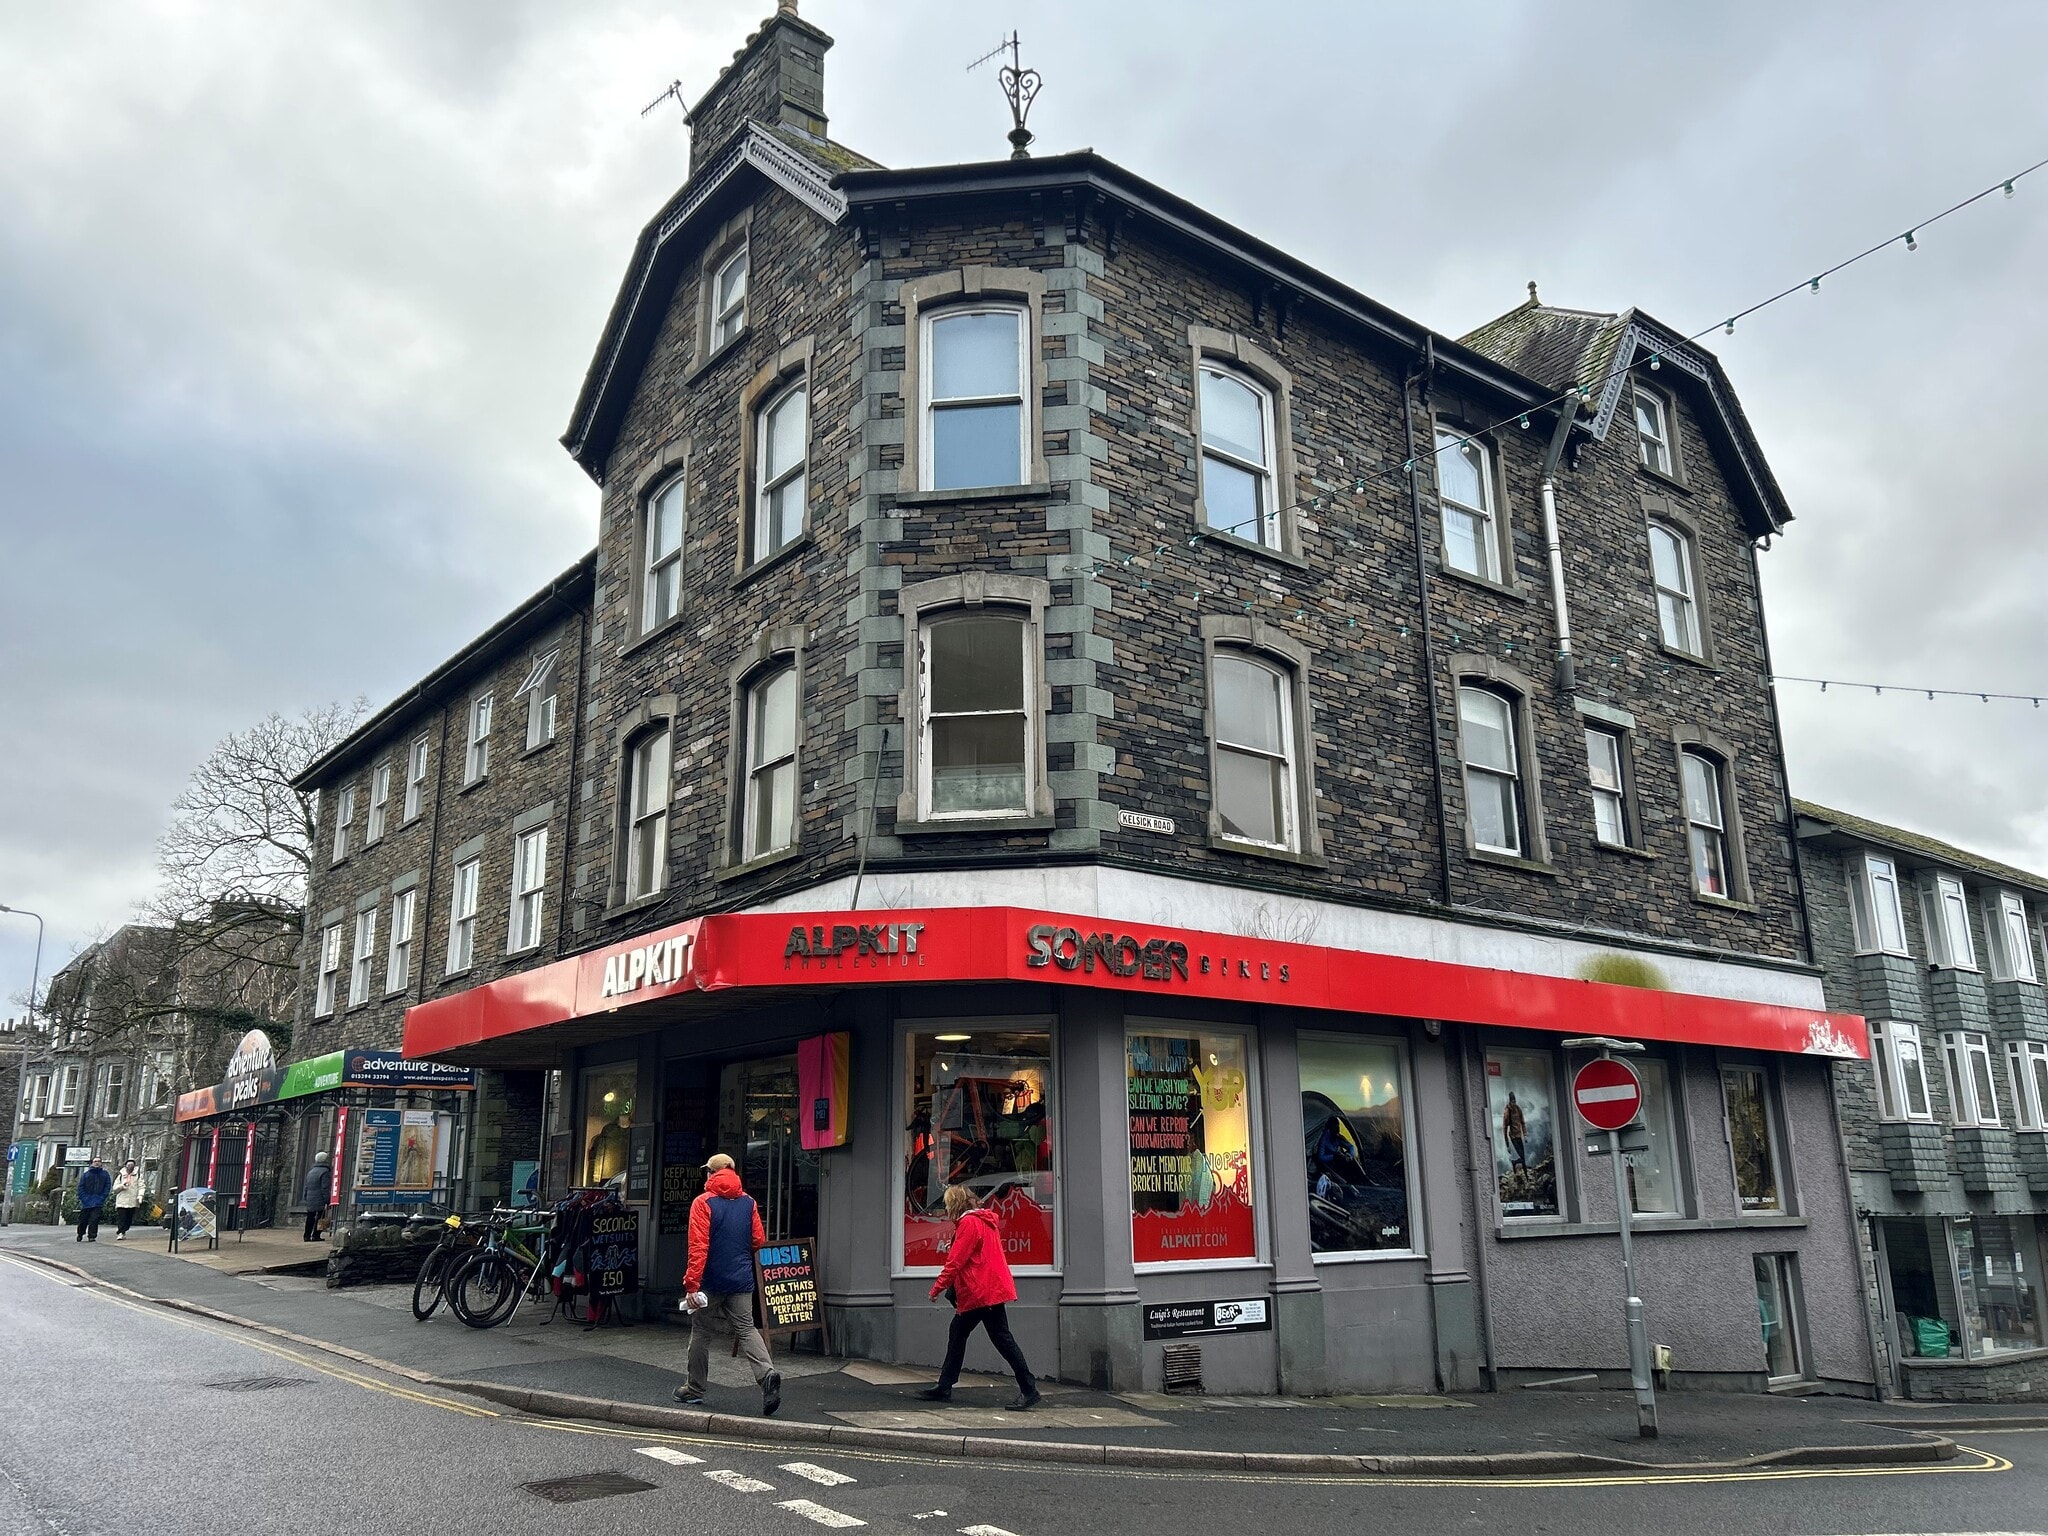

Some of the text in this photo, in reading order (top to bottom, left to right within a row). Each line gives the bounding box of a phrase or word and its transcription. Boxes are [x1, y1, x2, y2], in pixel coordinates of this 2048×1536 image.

[1122, 813, 1171, 831] KELSICK ROAD
[783, 921, 925, 958] ALPKIT
[1026, 924, 1290, 982] SONDER BIKES
[601, 932, 692, 998] ALPKIT
[784, 954, 926, 971] AMBLESIDE
[228, 1048, 270, 1078] adventure
[362, 1058, 470, 1075] adventure peaks
[1165, 1057, 1188, 1073] COAT?
[314, 1072, 339, 1088] ADVENTURE
[1128, 1077, 1189, 1094] CAN WE WASH YOUR
[231, 1073, 259, 1109] peaks
[1129, 1094, 1189, 1110] SLEEPING BAG?
[1130, 1116, 1190, 1132] CAN WE REPROOF
[1131, 1133, 1191, 1149] YOUR WATERPROOF?
[332, 1114, 345, 1197] SALE
[242, 1129, 254, 1203] SALE
[664, 1167, 684, 1178] KEEP
[1131, 1156, 1192, 1174] CAN WE MEND YOUR
[663, 1178, 699, 1190] OLD KIT
[1132, 1174, 1192, 1192] BROKEN HEART?
[663, 1189, 691, 1202] GOING!
[592, 1232, 635, 1245] WETSUITS
[1160, 1233, 1228, 1249] ALPKIT.COM
[759, 1245, 801, 1266] WASH
[602, 1270, 624, 1287] £50
[763, 1265, 811, 1281] REPROOF
[764, 1283, 787, 1297] GEAR
[765, 1291, 817, 1306] LOOKED AFTER
[772, 1302, 814, 1315] PERFORMS
[1149, 1307, 1205, 1321] Luigi's Restaurant
[778, 1311, 813, 1325] BETTER!
